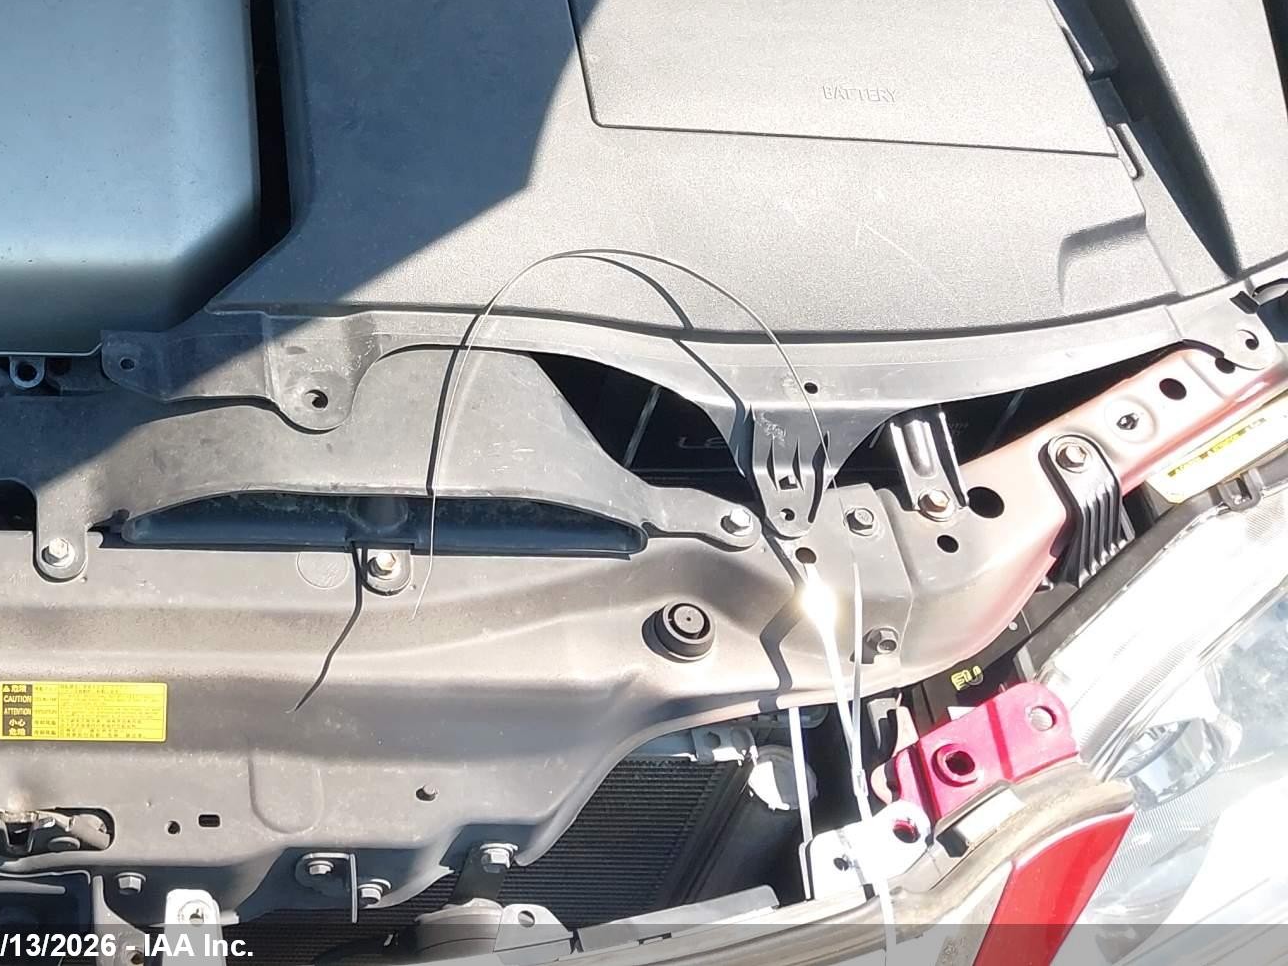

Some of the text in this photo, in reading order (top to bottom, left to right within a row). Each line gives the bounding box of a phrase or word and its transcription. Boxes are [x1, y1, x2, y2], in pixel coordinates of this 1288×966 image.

[822, 85, 896, 103] BATTERY
[3, 695, 32, 704] CAUTION
[3, 707, 32, 716] ATTENTION
